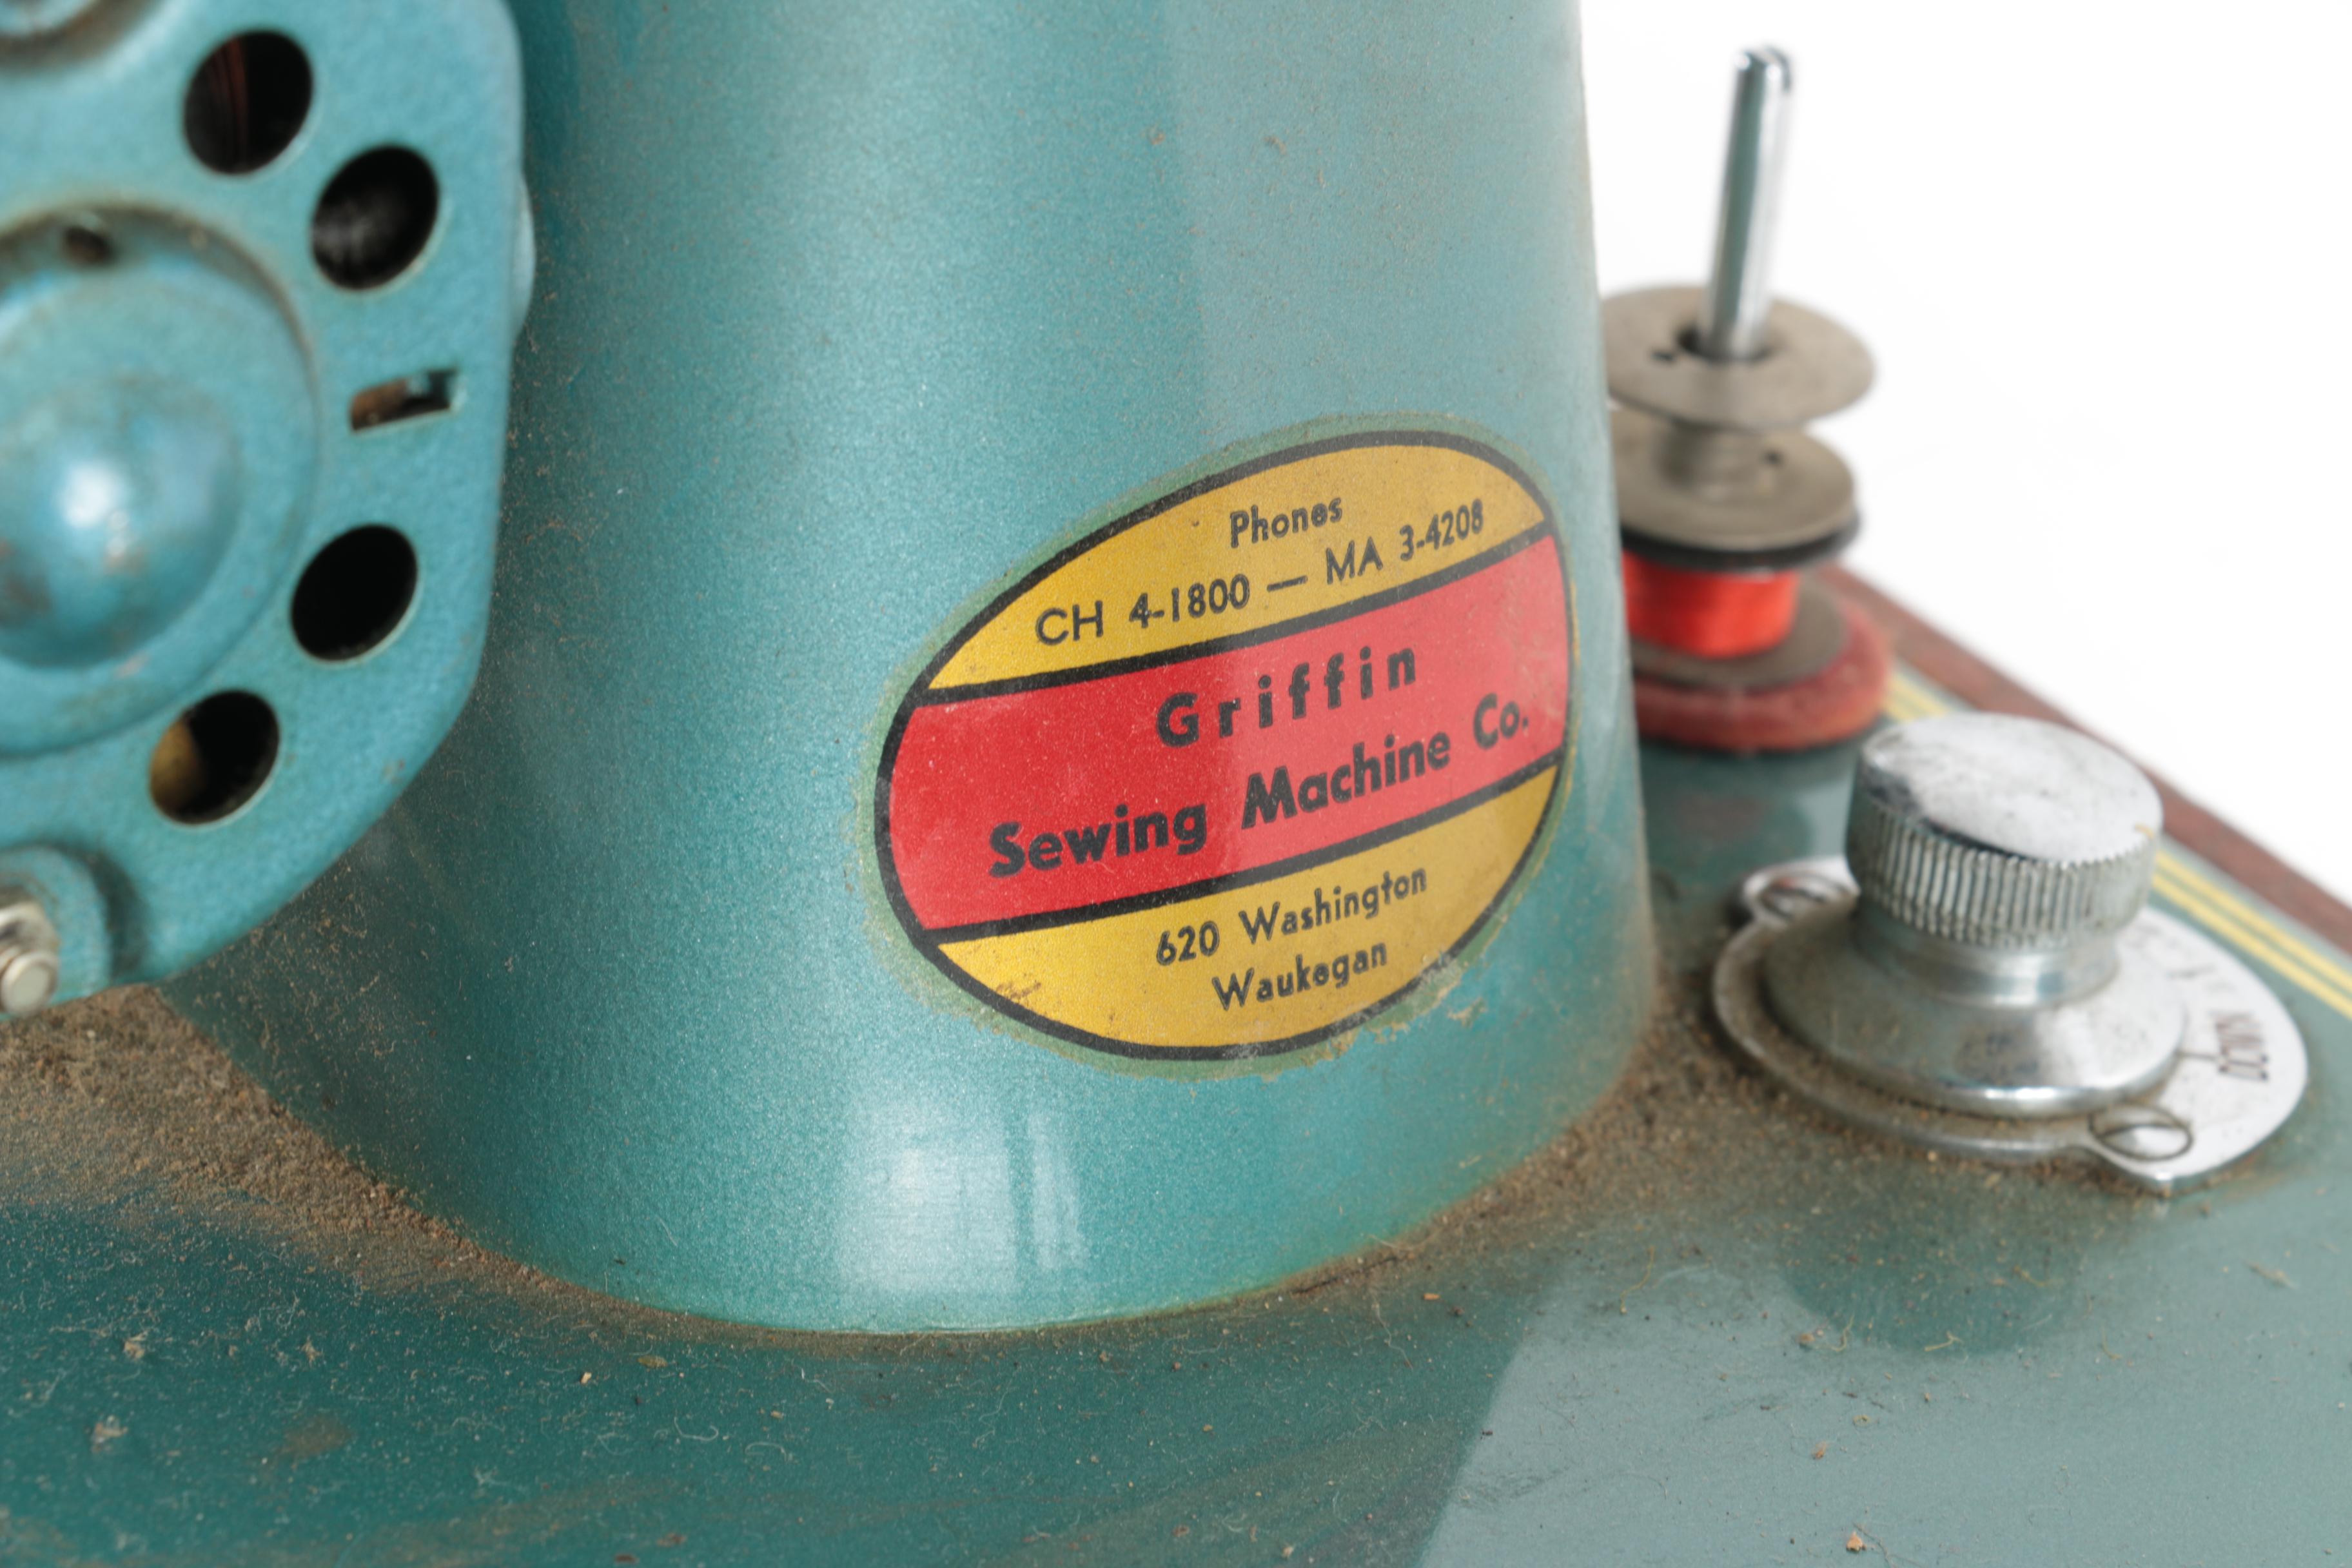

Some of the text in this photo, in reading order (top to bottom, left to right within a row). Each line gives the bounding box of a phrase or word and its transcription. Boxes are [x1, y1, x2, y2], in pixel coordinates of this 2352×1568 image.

[1035, 600, 1103, 645] CH
[1129, 574, 1250, 629] 4-1800
[1326, 536, 1383, 584] MA
[1400, 499, 1483, 561] 3-4208
[1230, 498, 1342, 548] Phones
[1155, 647, 1415, 748] Griffin
[990, 693, 1529, 877] Sewing Machine Co.
[1156, 869, 1426, 966] 620 Washington
[1212, 943, 1386, 1011] Waukegan
